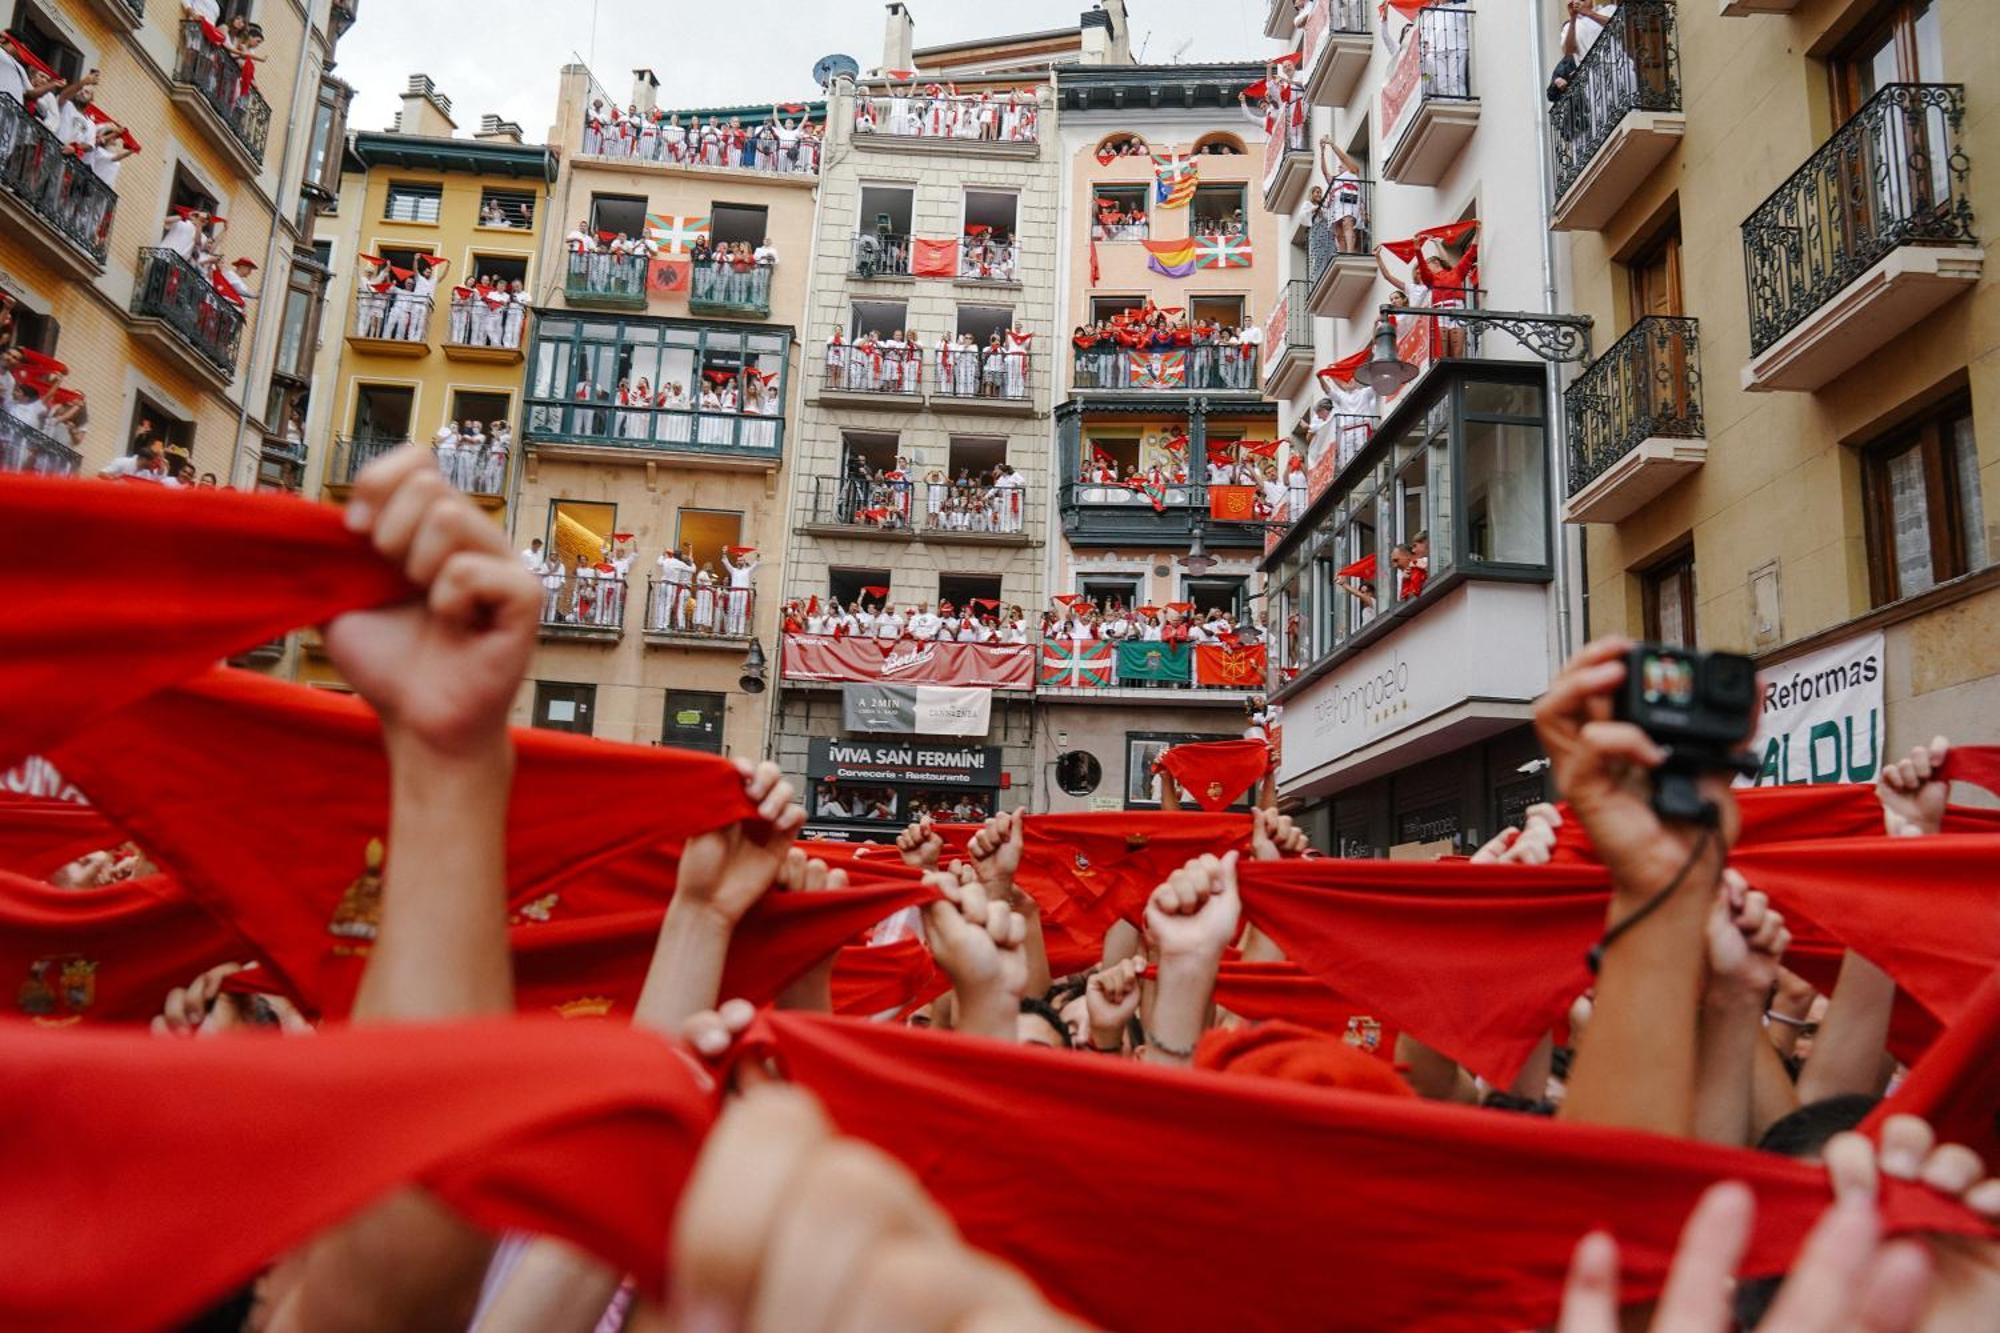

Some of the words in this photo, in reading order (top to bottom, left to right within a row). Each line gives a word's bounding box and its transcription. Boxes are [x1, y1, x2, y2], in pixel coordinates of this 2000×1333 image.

[1763, 655, 1878, 714] Reformas
[858, 698, 866, 707] A
[829, 746, 872, 764] ¡VIVA
[875, 749, 913, 766] SAN
[917, 748, 985, 769] FERMÍN!
[1755, 708, 1878, 787] ALDU
[837, 768, 896, 779] Cervecería
[905, 771, 970, 782] Restaurante
